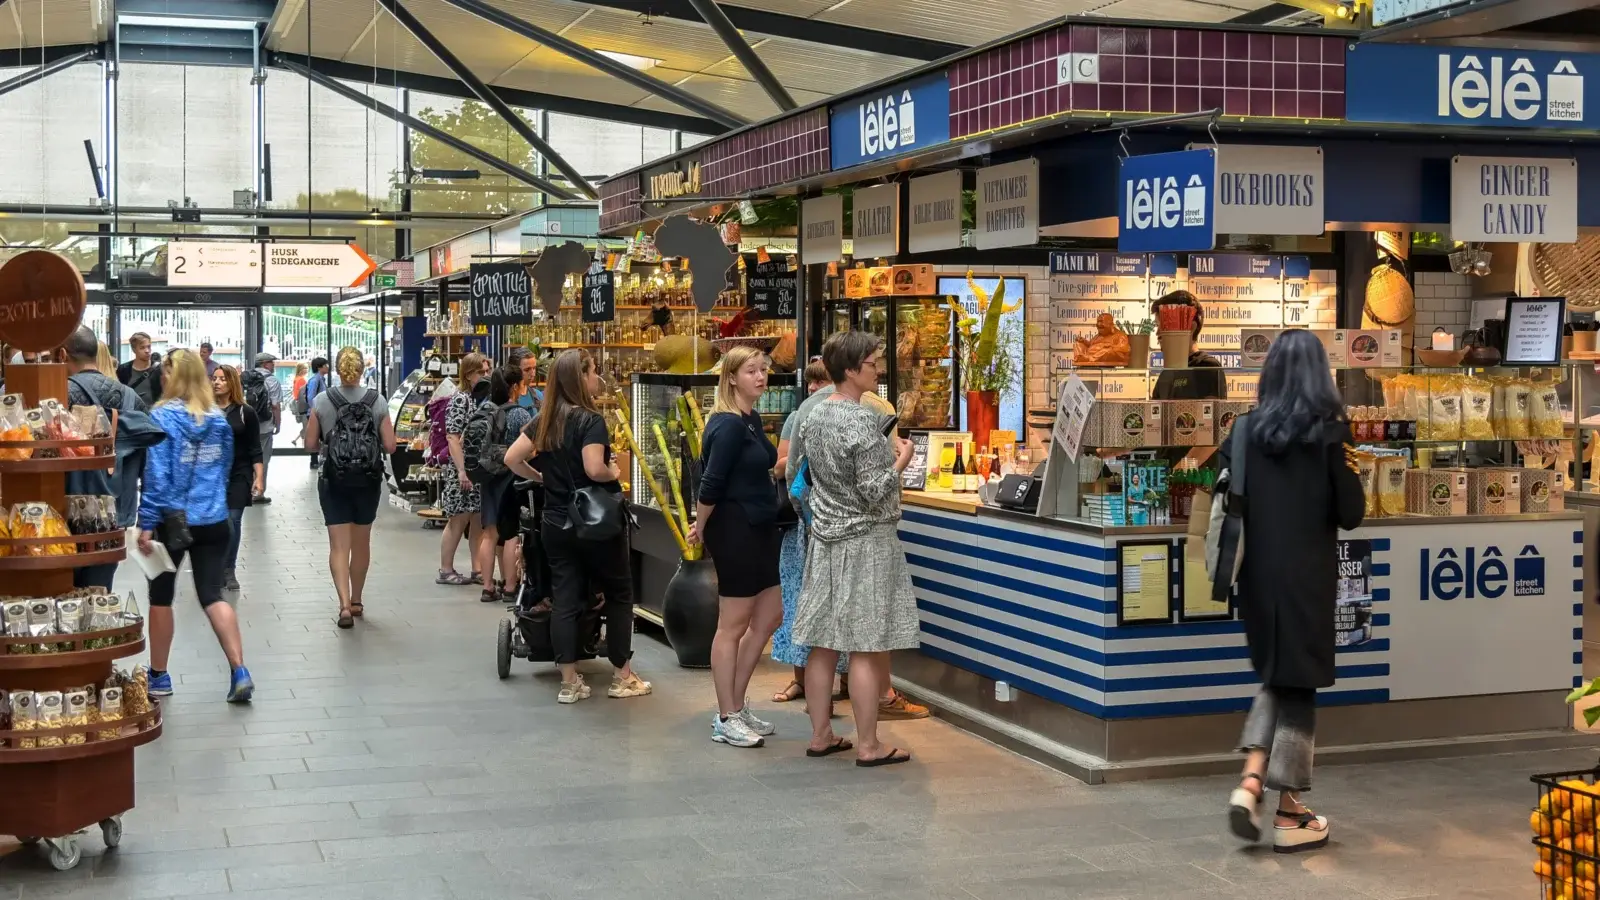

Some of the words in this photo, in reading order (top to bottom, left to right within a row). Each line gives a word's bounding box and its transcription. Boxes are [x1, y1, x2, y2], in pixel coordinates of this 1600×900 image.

[1061, 60, 1067, 78] 6
[1078, 58, 1093, 77] C
[1438, 54, 1541, 120] lêlê
[1549, 100, 1575, 109] street
[1549, 109, 1581, 119] kitchen
[859, 95, 898, 156] lêlê
[1480, 164, 1550, 196] GINGER
[983, 175, 1028, 204] VIETNAMESE
[1220, 172, 1314, 207] OKBOOKS
[1126, 176, 1181, 230] lêlê
[857, 205, 891, 237] SALATER
[986, 206, 1025, 232] BAGUETTES
[1185, 209, 1200, 217] street
[1185, 216, 1204, 225] kitchen
[1483, 203, 1548, 234] CANDY
[550, 222, 559, 232] C
[271, 248, 298, 256] HUSK
[174, 256, 186, 273] 2
[271, 257, 340, 265] SIDEGANGENE
[1056, 253, 1083, 271] BÁNH
[1195, 257, 1214, 273] BAO
[473, 271, 527, 297] SPIRITUS
[1057, 281, 1098, 297] Five-spice
[1100, 281, 1119, 297] pork
[1195, 282, 1234, 298] Five-spice
[1236, 283, 1254, 298] pork
[50, 296, 75, 317] MIX
[1222, 307, 1252, 319] chicken
[1104, 381, 1124, 394] cake
[1420, 545, 1508, 600] lêlê
[1515, 578, 1538, 587] street
[1515, 586, 1544, 596] kitchen
